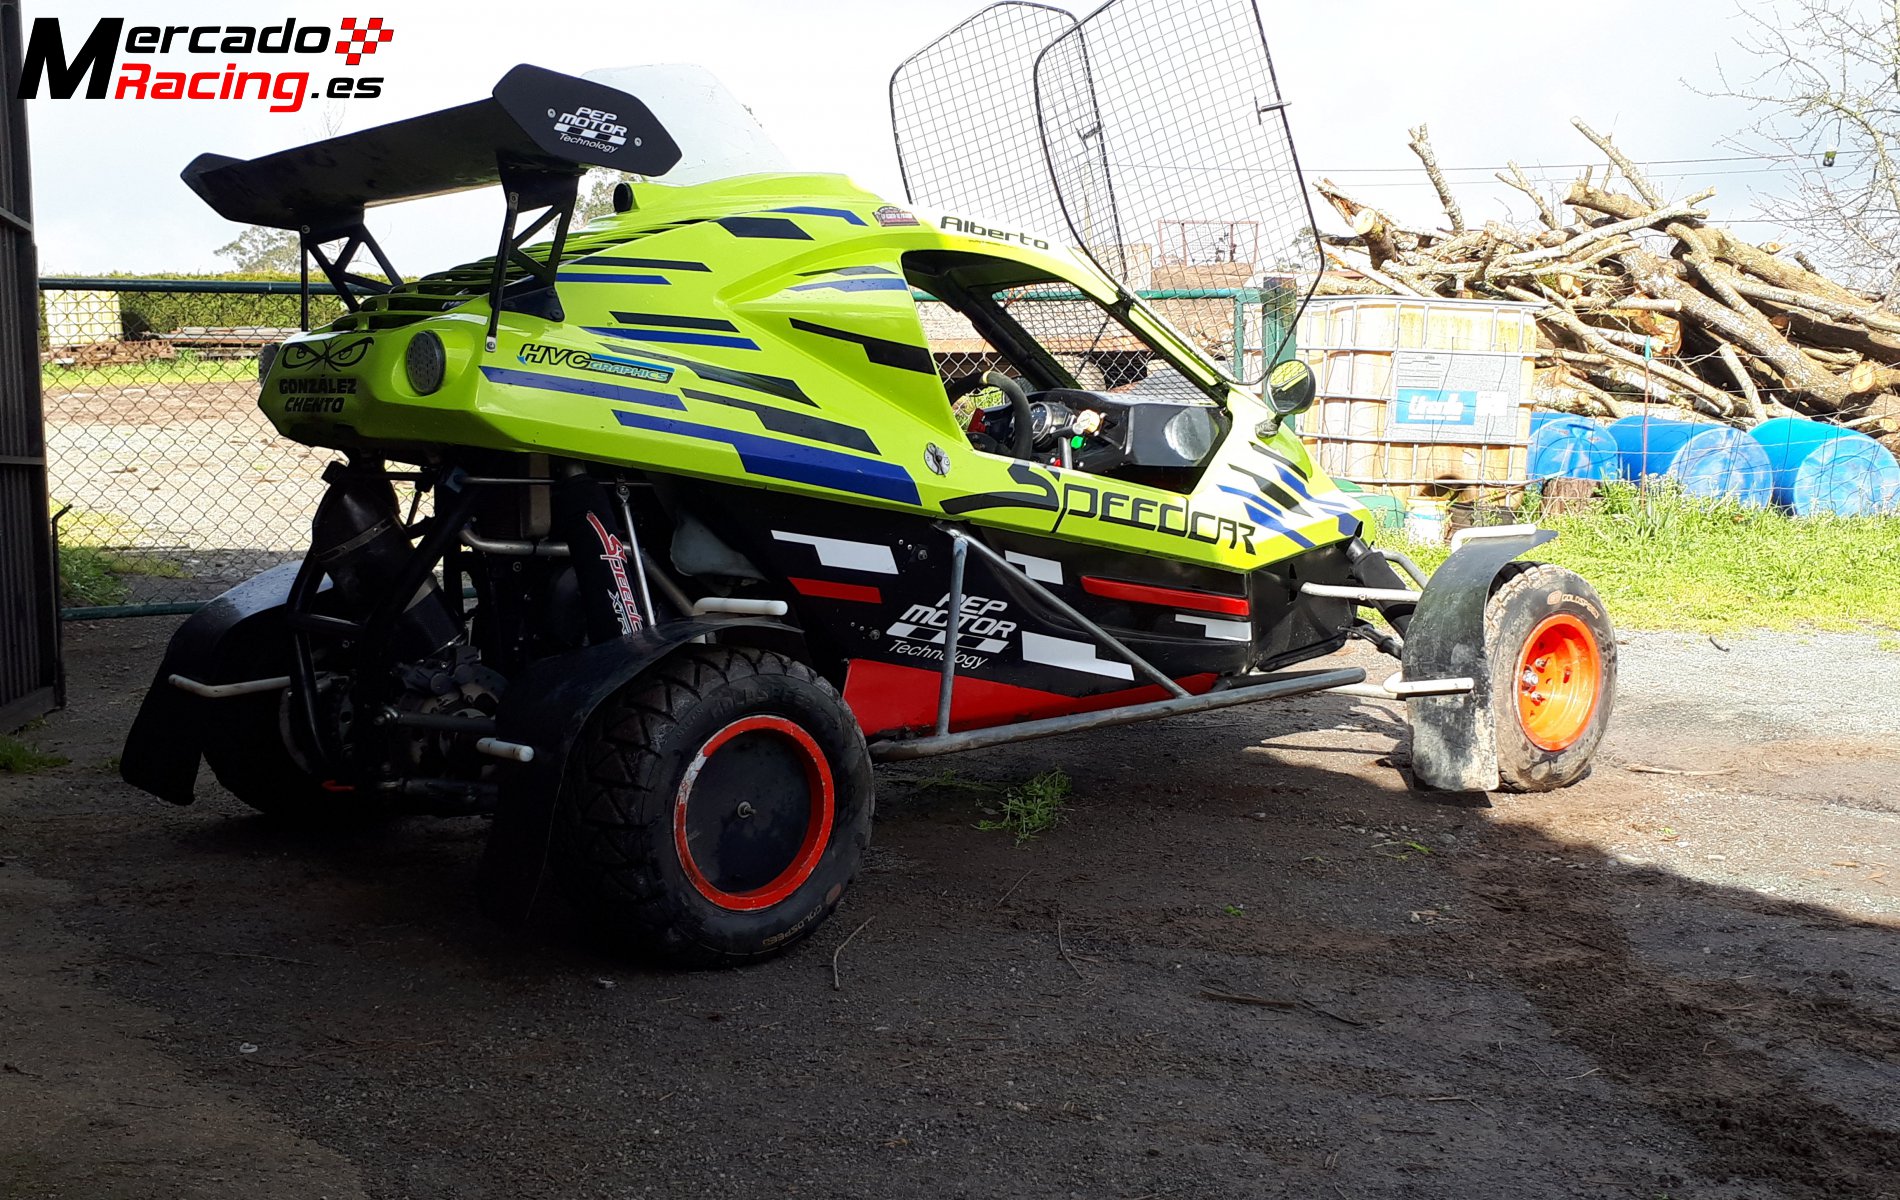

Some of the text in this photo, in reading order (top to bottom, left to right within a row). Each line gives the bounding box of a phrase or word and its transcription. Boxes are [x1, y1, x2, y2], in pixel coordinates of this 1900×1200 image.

[558, 112, 628, 137] MOTOR
[575, 106, 617, 122] PEP
[559, 132, 619, 154] Technology
[940, 215, 1049, 250] Alberto
[517, 343, 592, 369] HVC
[588, 360, 669, 382] GRAPHICS
[279, 374, 357, 395] GONZÁLEZ
[284, 396, 345, 414] CHENTO
